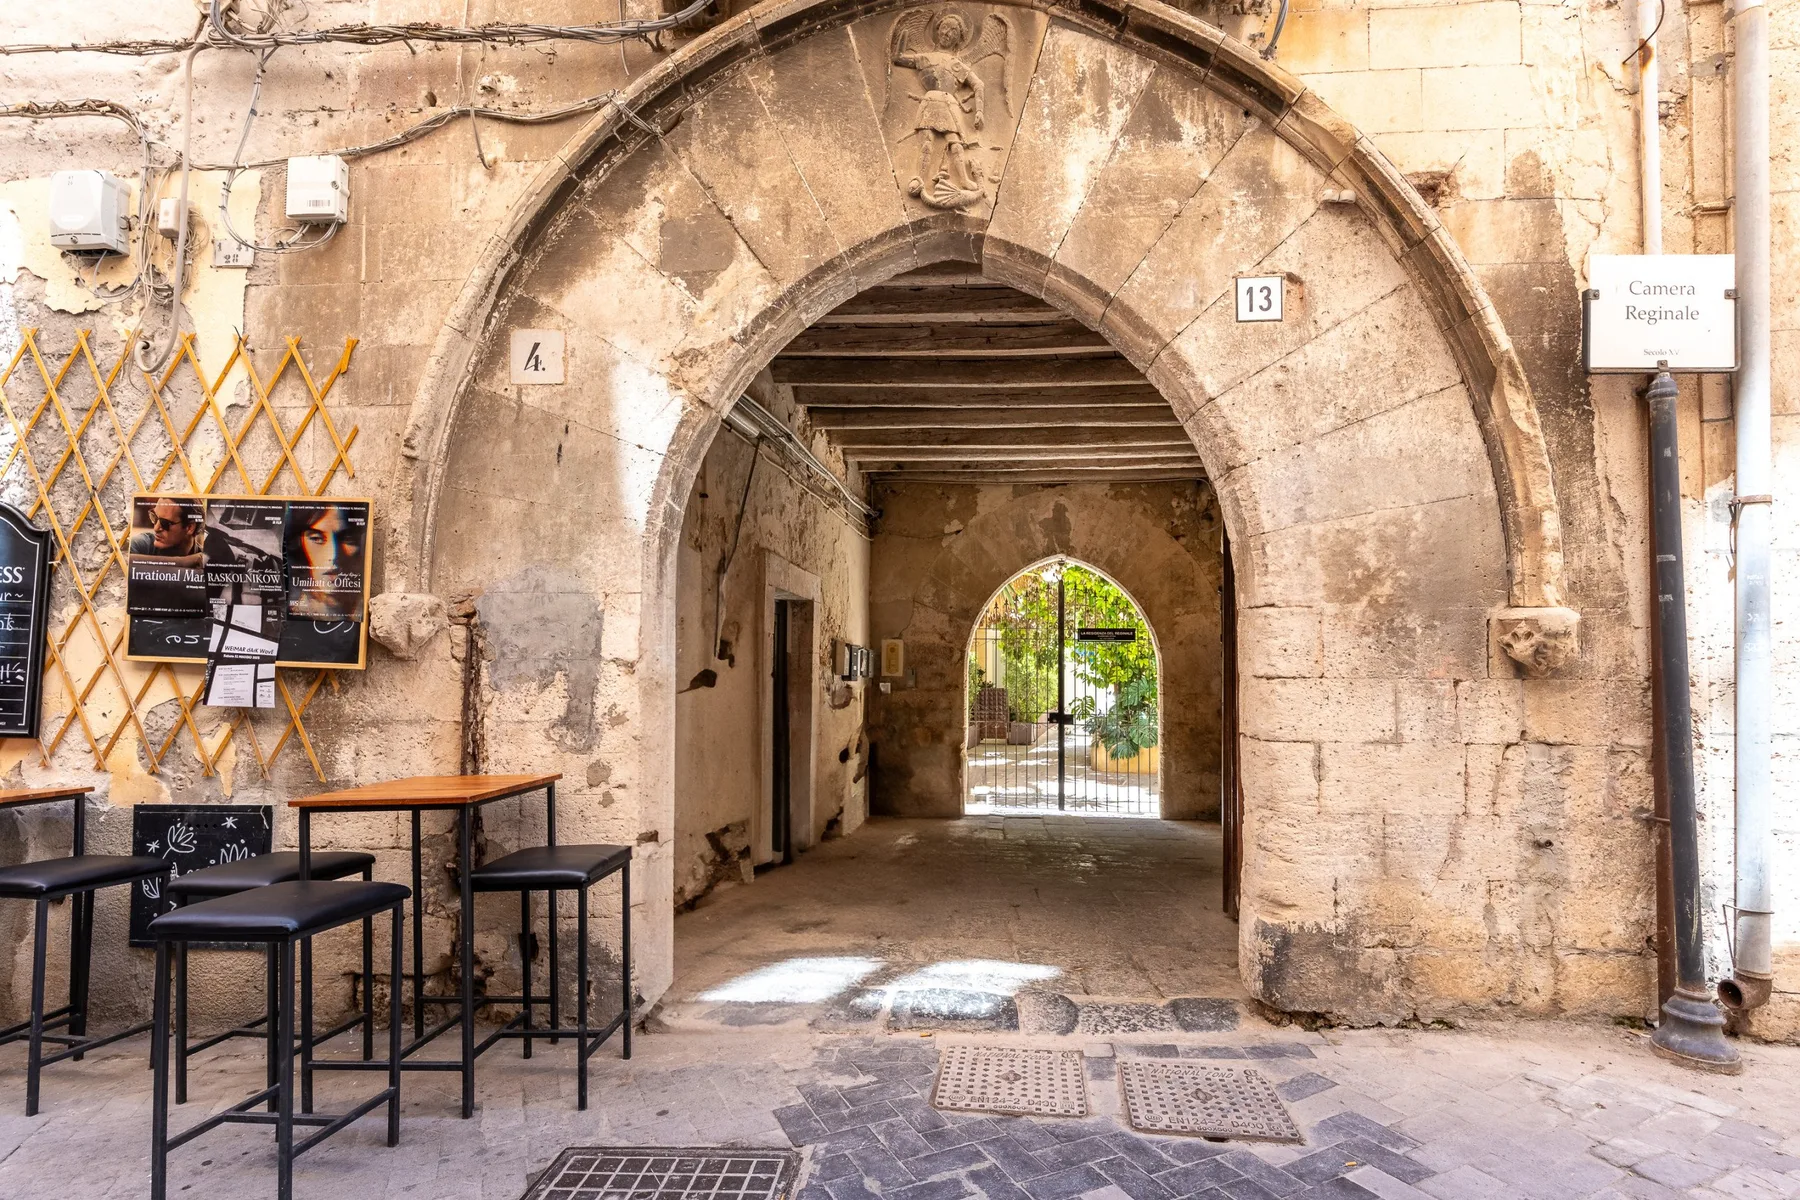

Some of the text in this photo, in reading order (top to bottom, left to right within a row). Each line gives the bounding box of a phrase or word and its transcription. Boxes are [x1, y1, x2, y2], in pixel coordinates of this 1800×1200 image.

[1629, 280, 1696, 296] Camera
[1246, 286, 1272, 313] 13
[1625, 305, 1700, 326] Reginale
[1643, 348, 1667, 356] Secolo
[131, 567, 181, 582] Irrational
[207, 572, 281, 584] RASKOLNIKOW
[292, 576, 325, 587] Umiliati
[334, 577, 361, 588] Offesi
[974, 1052, 1020, 1060] NATIONAL
[1150, 1068, 1200, 1077] NATIONAL
[1205, 1071, 1234, 1079] FOND
